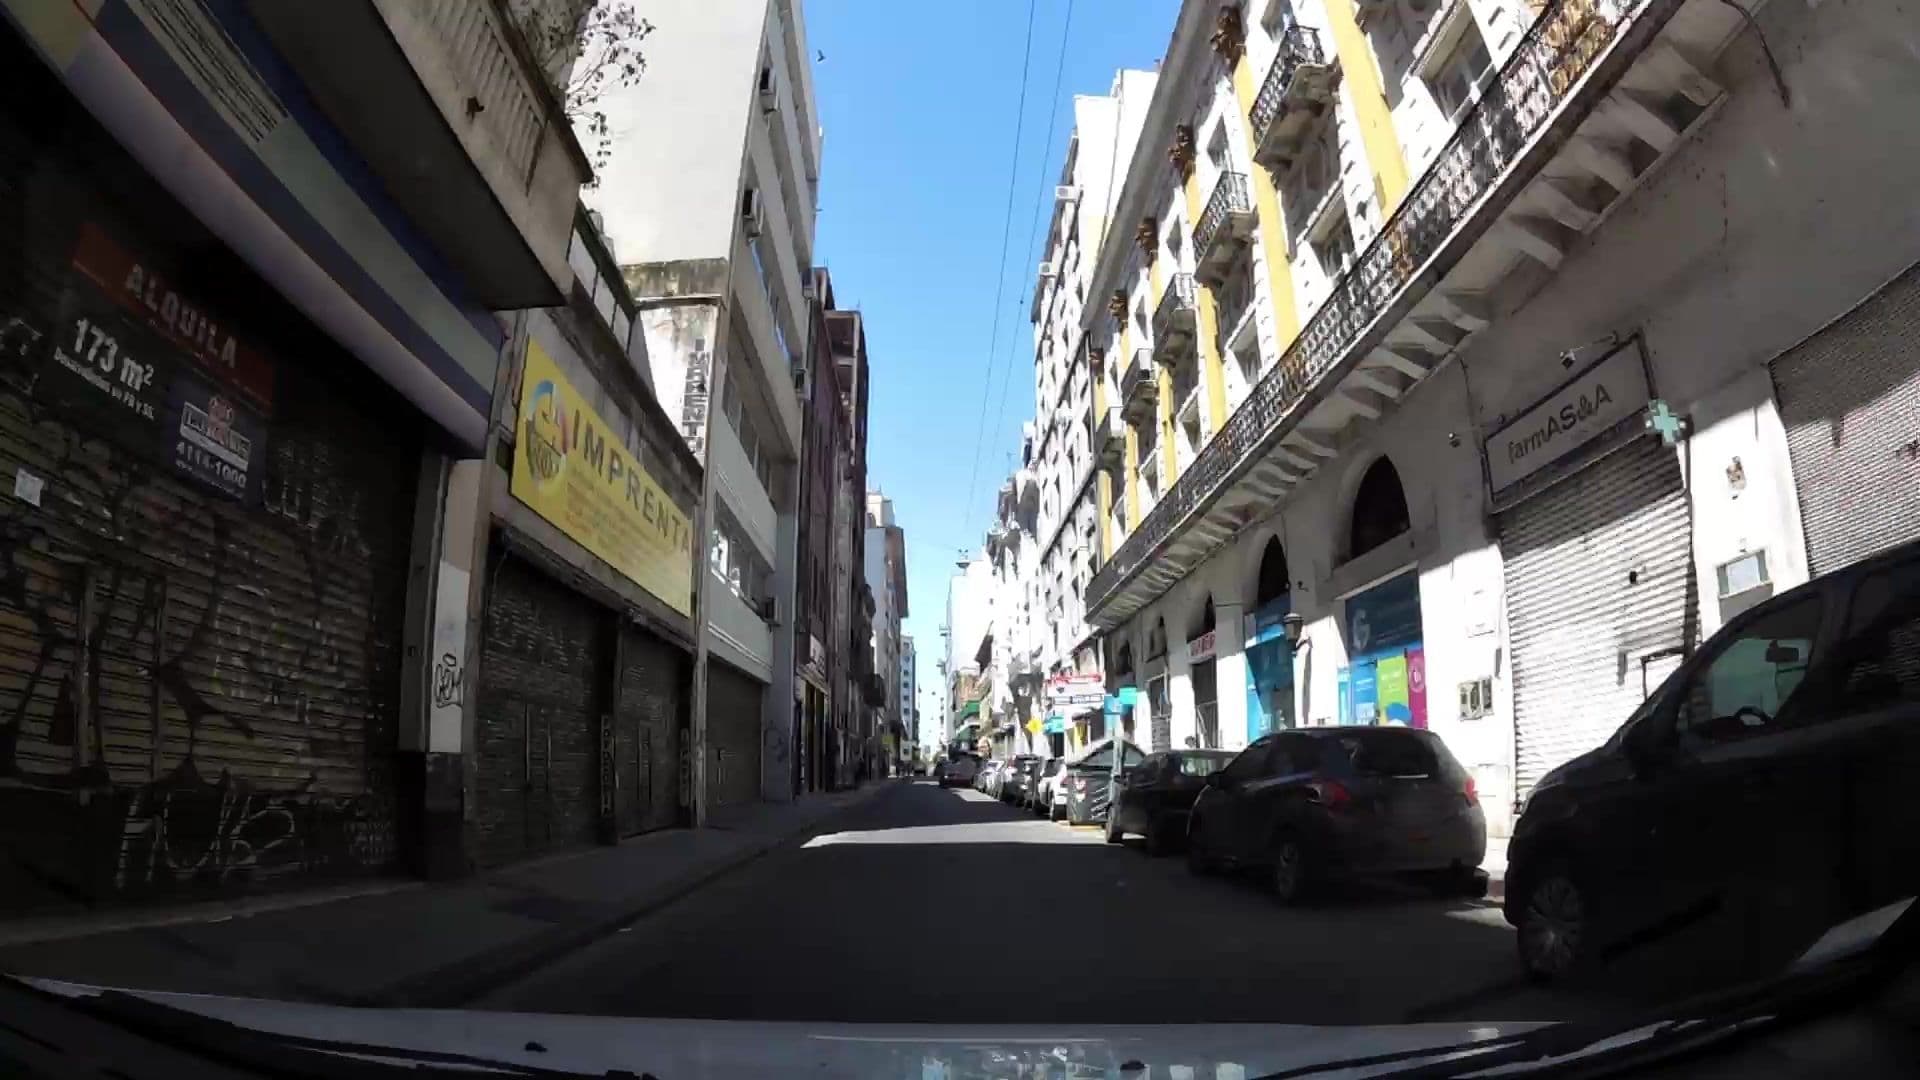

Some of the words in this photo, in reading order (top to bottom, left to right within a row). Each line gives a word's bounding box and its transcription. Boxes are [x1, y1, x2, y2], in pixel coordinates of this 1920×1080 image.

[74, 318, 118, 373] 173
[126, 264, 236, 368] ALQUILA
[1507, 383, 1612, 464] farmAS&A
[573, 409, 690, 553] IMPRENTA
